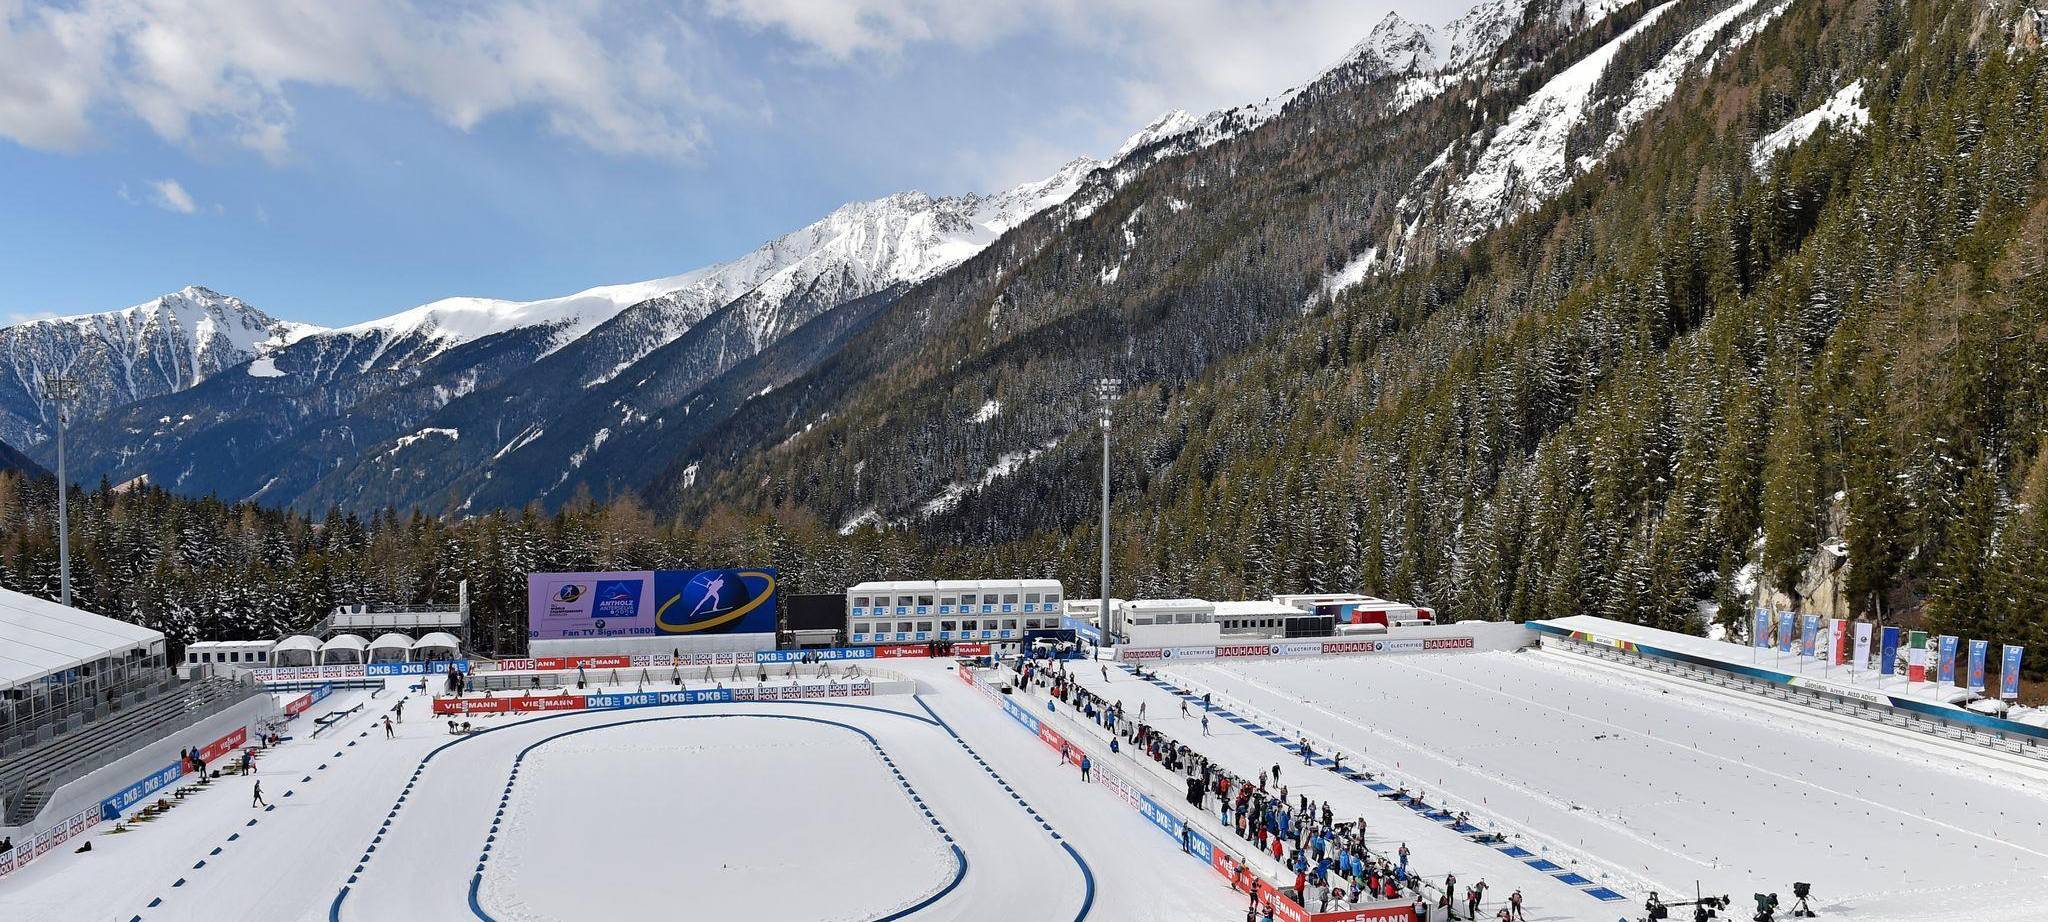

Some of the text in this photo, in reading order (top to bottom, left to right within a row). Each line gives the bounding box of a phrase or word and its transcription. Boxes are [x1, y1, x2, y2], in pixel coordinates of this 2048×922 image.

[598, 628, 626, 637] Signal
[1323, 642, 1373, 653] BAUHAUS
[1424, 638, 1472, 650] BAUHAUS
[816, 651, 836, 659] DKB
[846, 650, 865, 658] DKB
[884, 646, 923, 657] VIESSMANN
[1217, 646, 1270, 656] BAUHAUS
[368, 666, 391, 674] DKB
[402, 664, 424, 674] DKB
[624, 696, 647, 705] DKB
[662, 694, 685, 703] DKB
[698, 692, 720, 700] DKB
[444, 700, 498, 712] VIESSMANN
[522, 698, 574, 710] VIESSMANN
[588, 697, 612, 706] DKB
[164, 768, 176, 784] DKB
[144, 776, 158, 794] DKB
[124, 788, 138, 805] DKB
[1192, 836, 1206, 857] DKB
[1264, 891, 1301, 921] VIESSMANN
